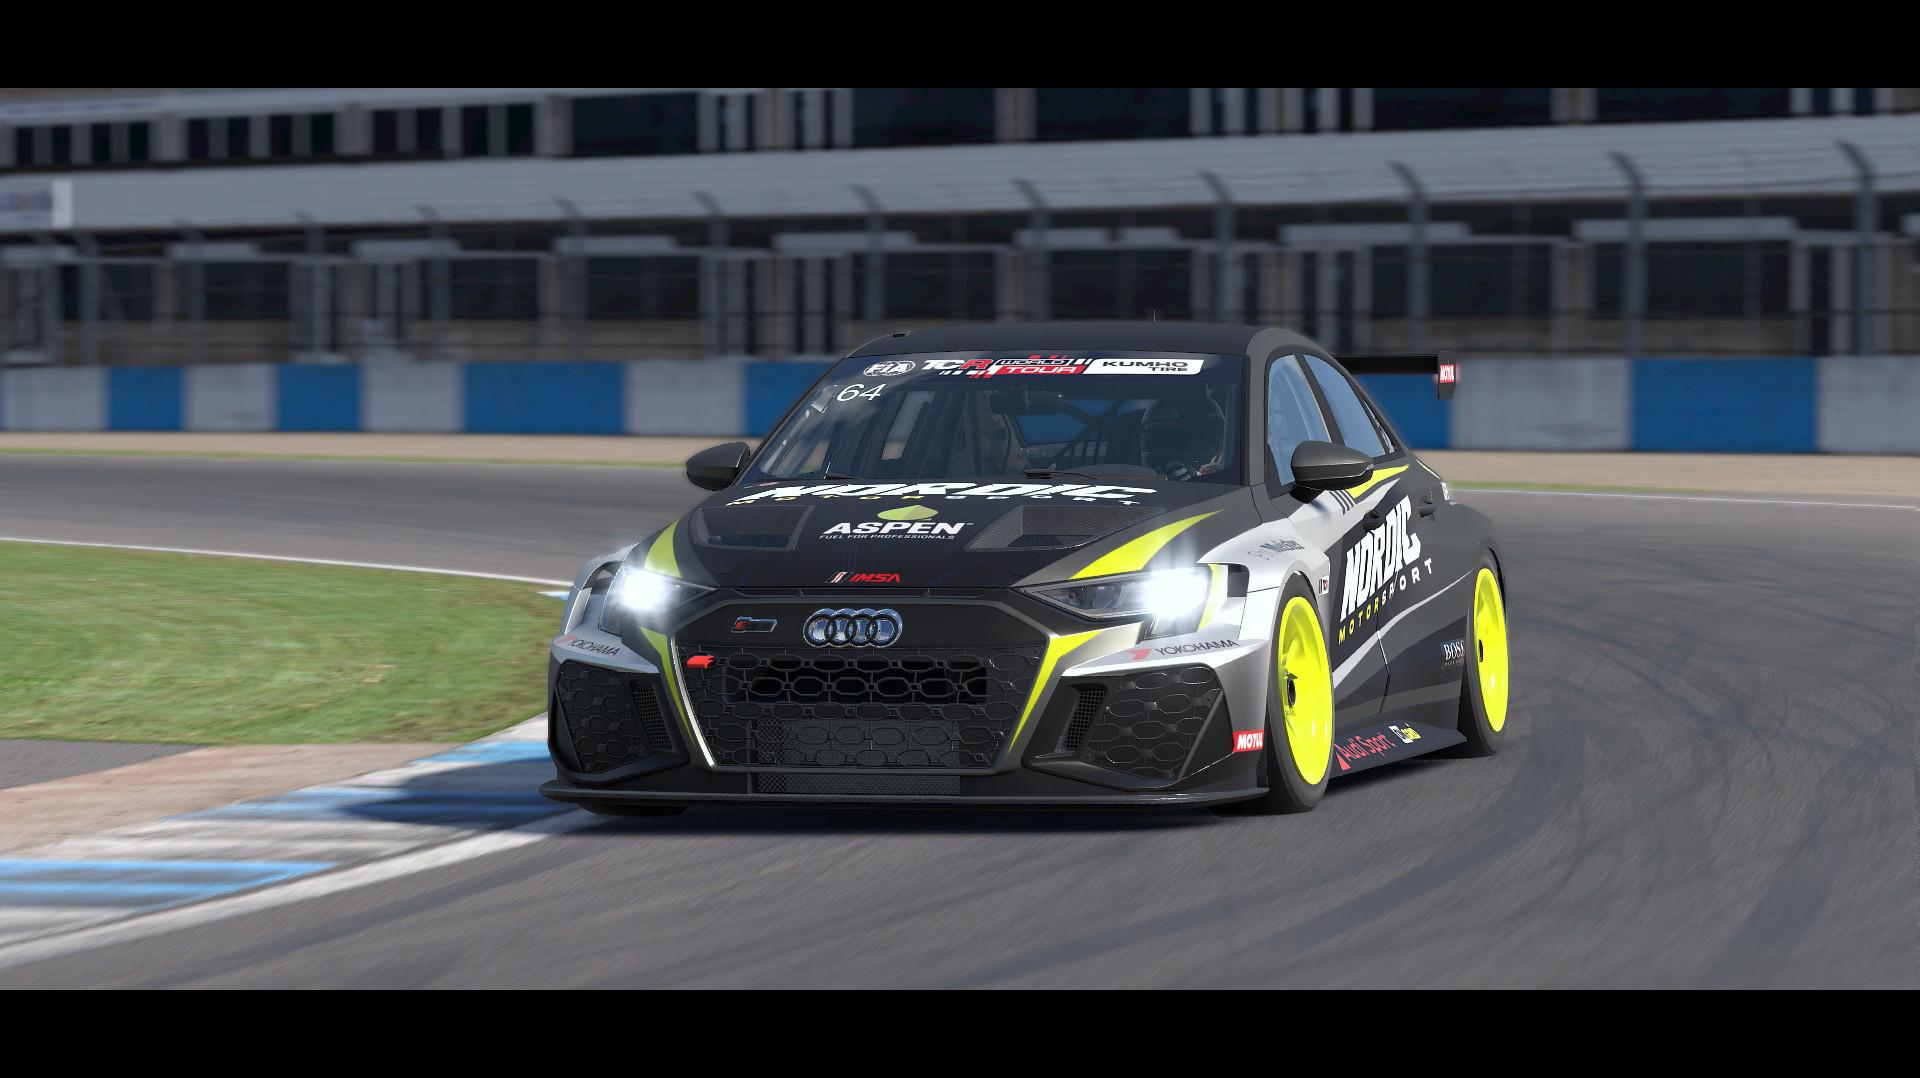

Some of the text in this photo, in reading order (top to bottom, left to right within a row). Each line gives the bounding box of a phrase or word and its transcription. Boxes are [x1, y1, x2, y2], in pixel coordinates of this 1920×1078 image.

[866, 362, 908, 374] FIA
[921, 359, 993, 370] TCR
[1006, 366, 1077, 374] TOUR
[836, 383, 887, 402] 64
[734, 482, 1158, 502] NORDIC
[822, 522, 966, 535] ASPEN
[1339, 495, 1422, 623] NORDIC
[849, 572, 901, 583] IMSA
[1338, 558, 1433, 645] MOTORSPORT
[1154, 638, 1239, 656] YOKOHAMA
[1334, 736, 1369, 762] Audi
[1355, 732, 1397, 757] Sport
